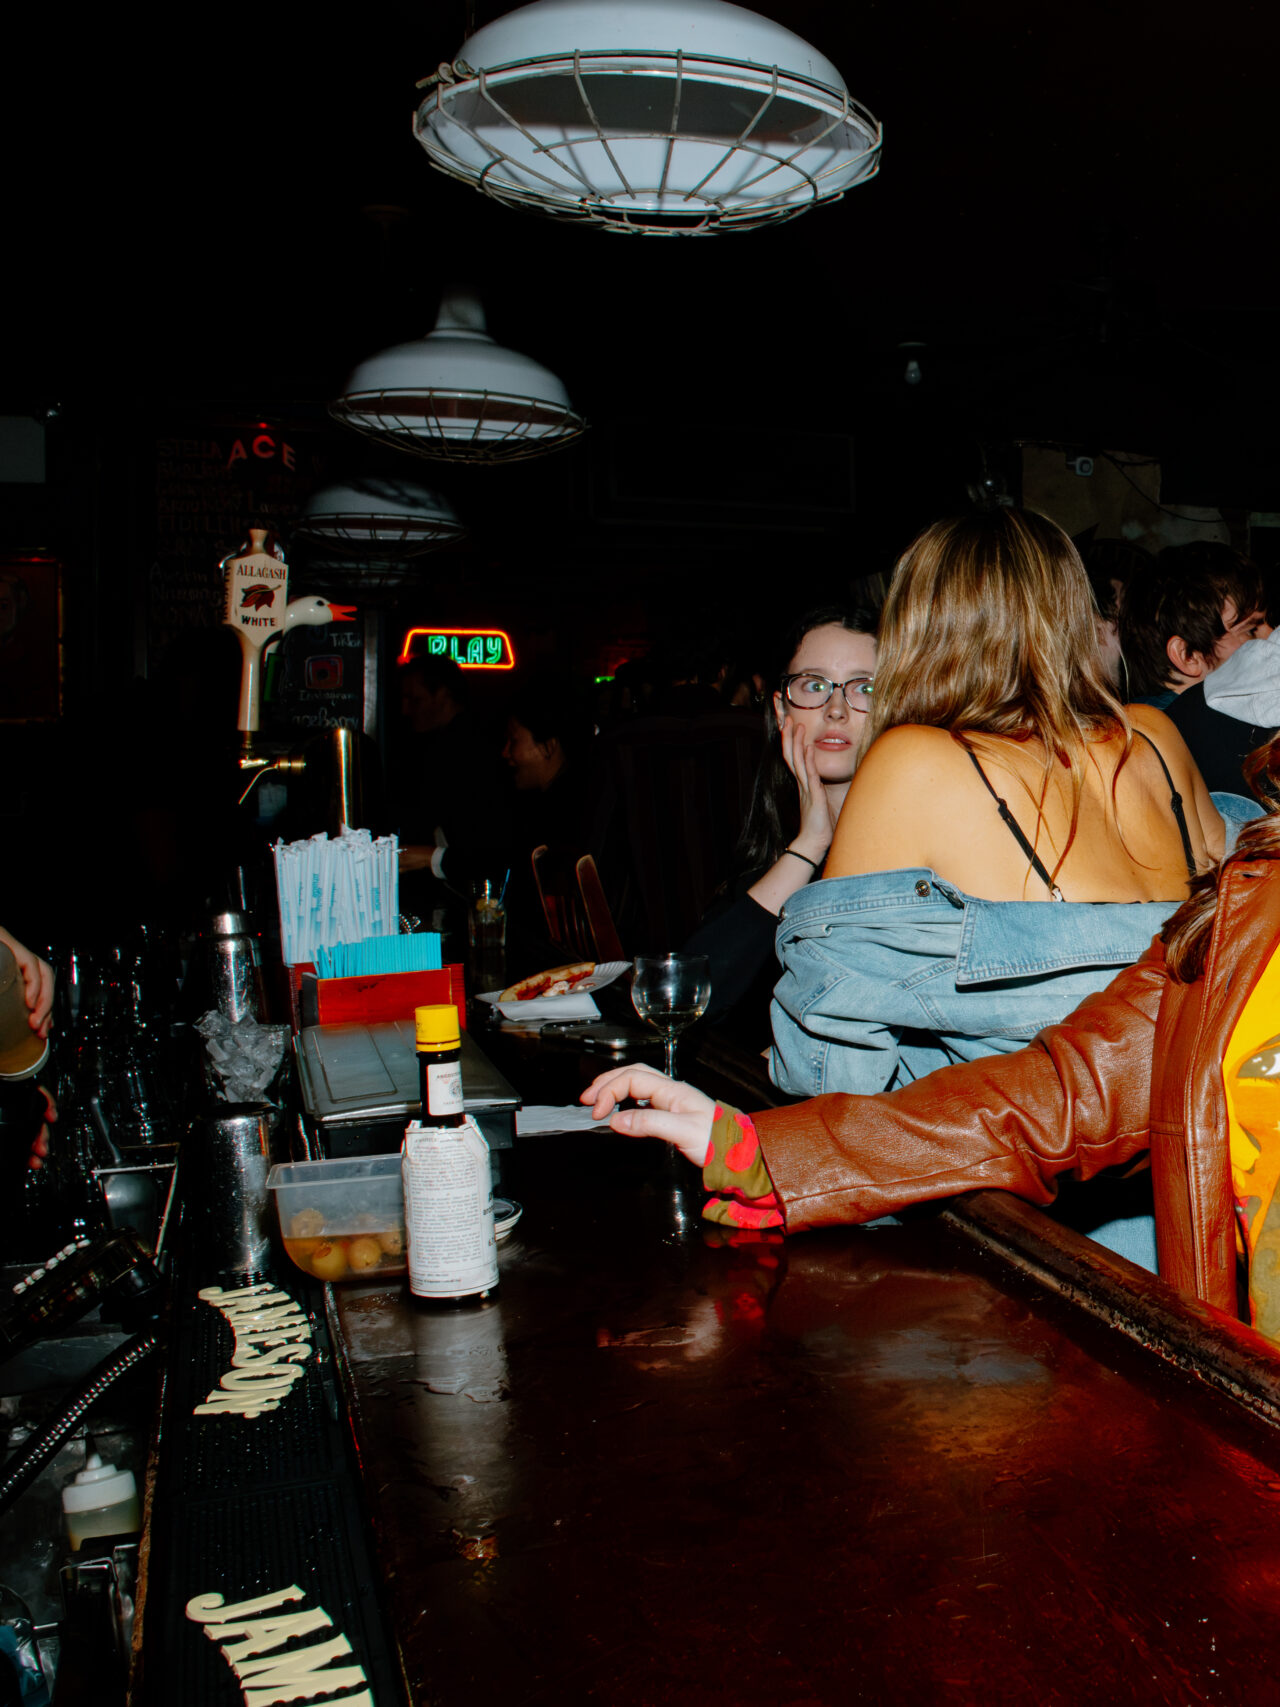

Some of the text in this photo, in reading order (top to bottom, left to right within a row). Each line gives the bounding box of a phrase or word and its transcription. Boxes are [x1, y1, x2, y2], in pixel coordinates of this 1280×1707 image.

[226, 434, 297, 472] ACE
[236, 564, 286, 580] ALLAGASH
[241, 614, 277, 627] WHITE
[428, 635, 502, 664] PLAY
[193, 1282, 312, 1419] JAMESON
[186, 1584, 375, 1707] JAM
